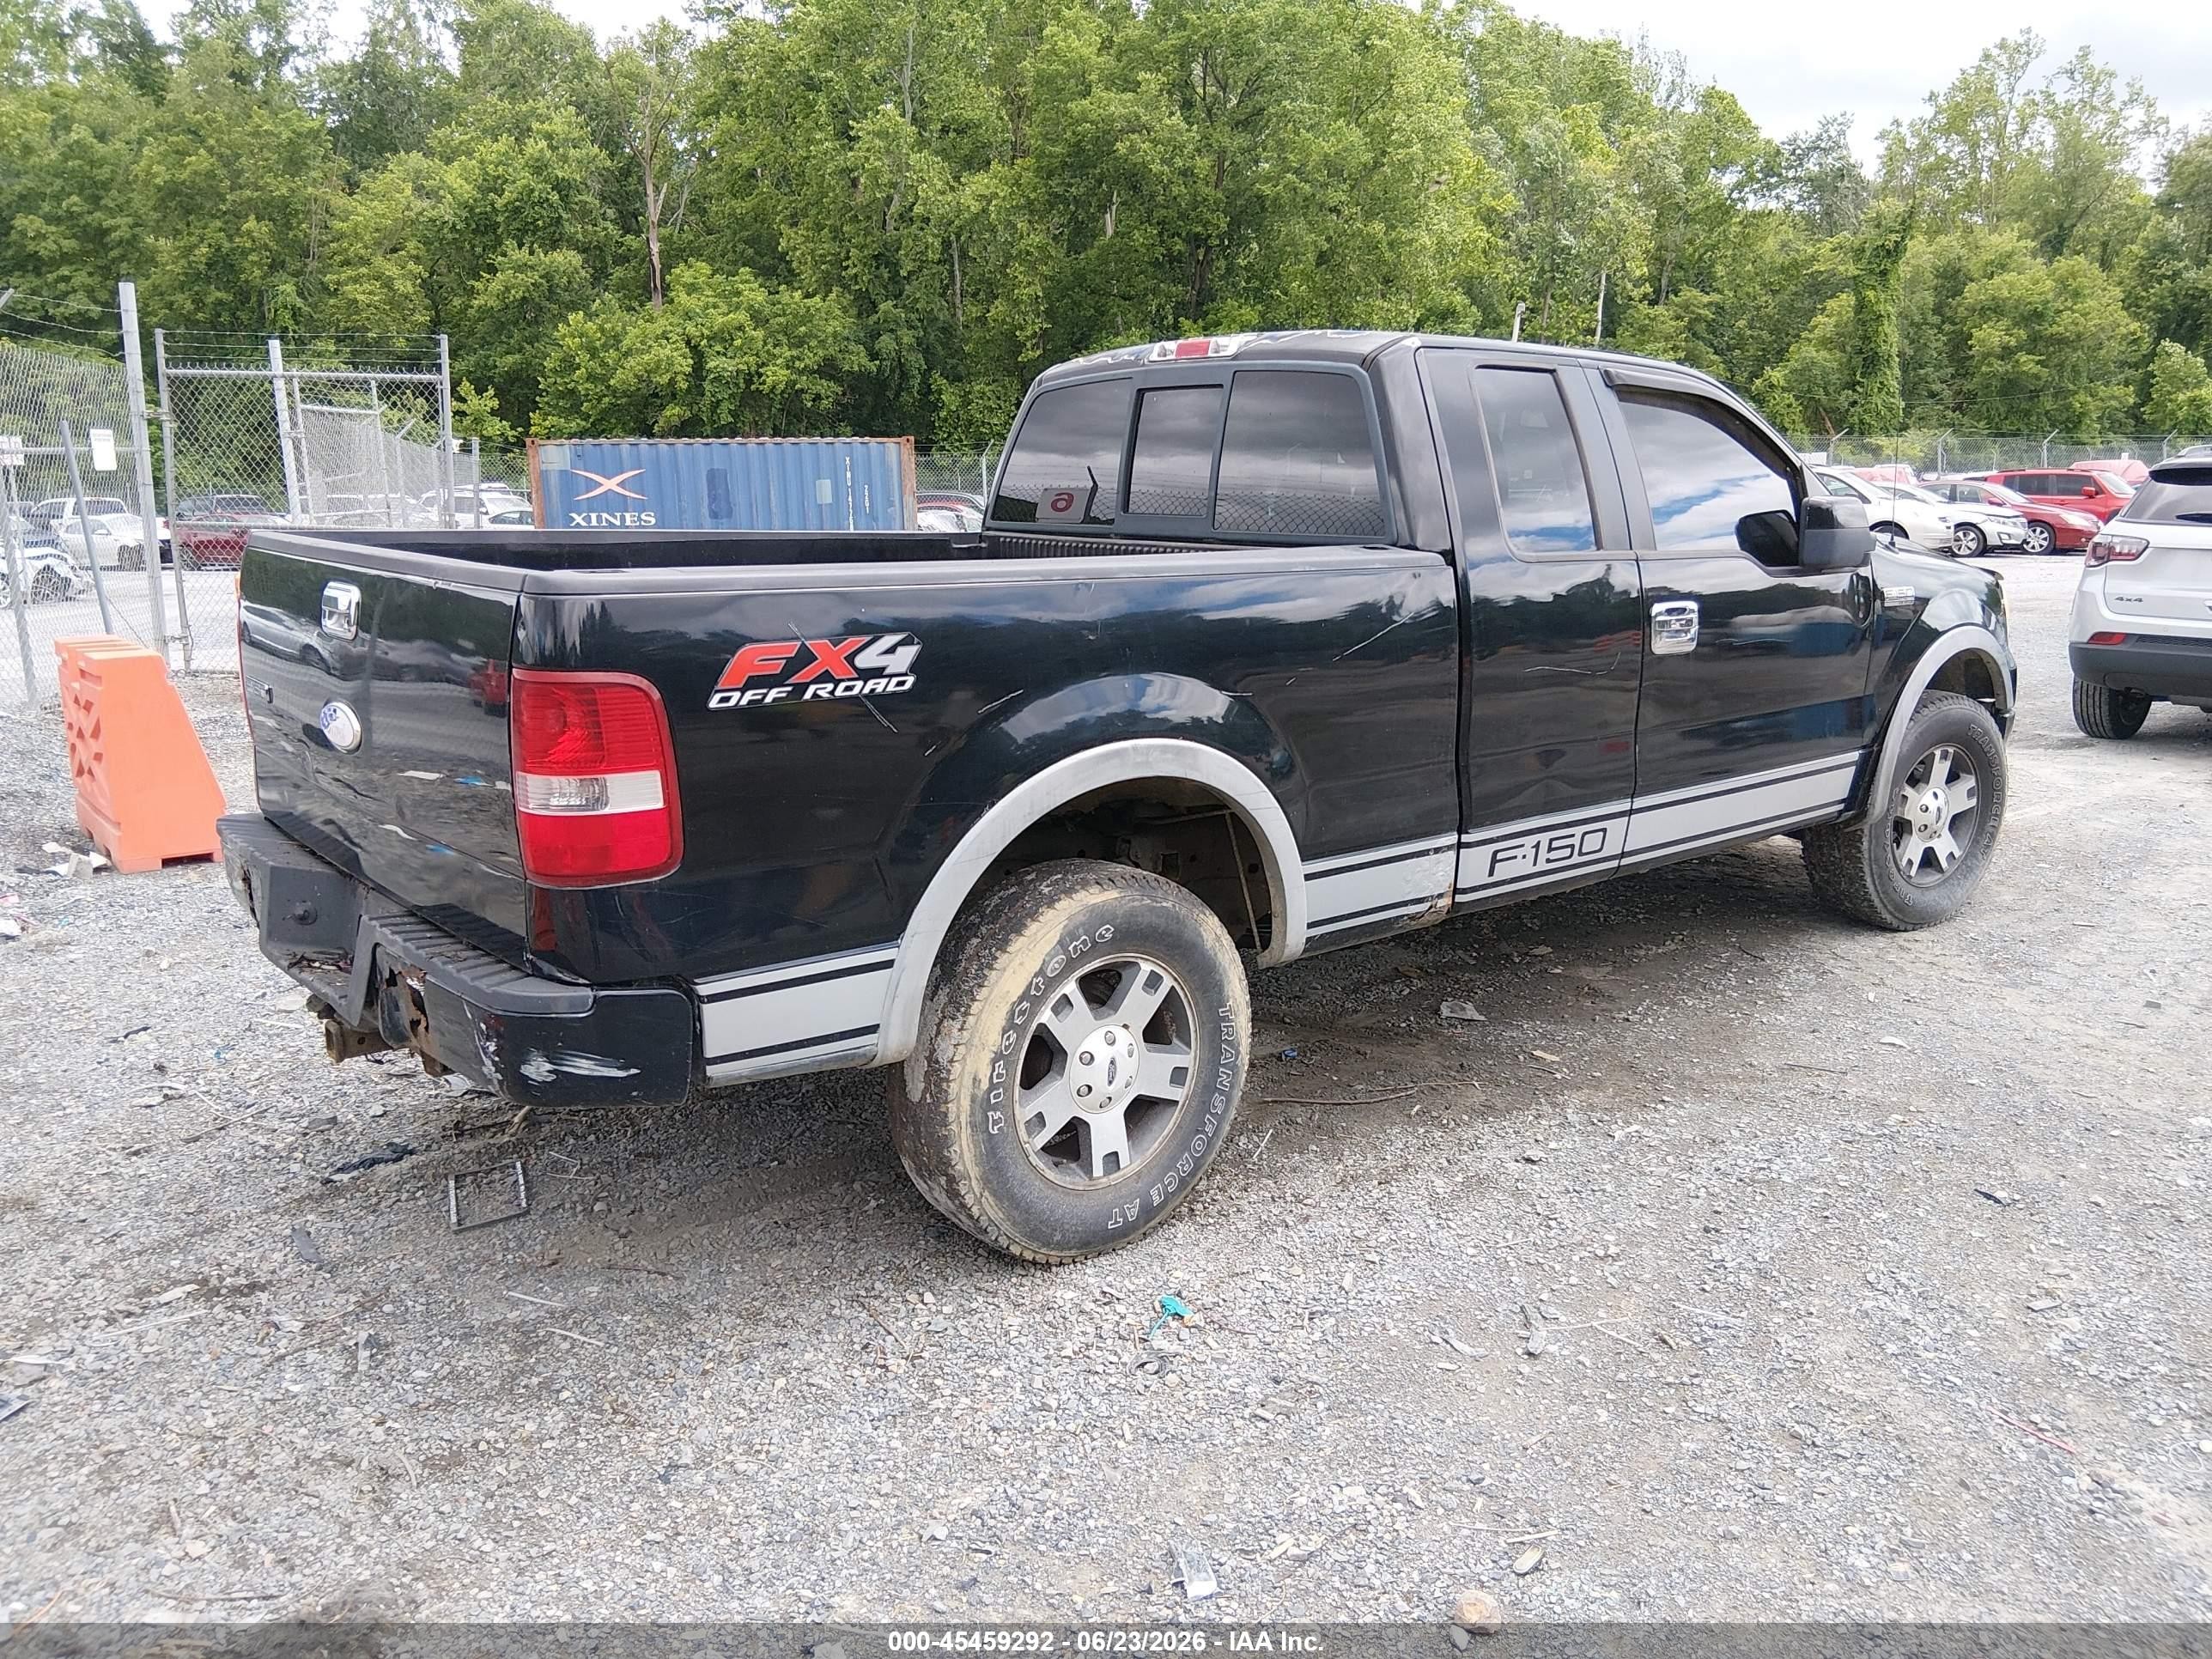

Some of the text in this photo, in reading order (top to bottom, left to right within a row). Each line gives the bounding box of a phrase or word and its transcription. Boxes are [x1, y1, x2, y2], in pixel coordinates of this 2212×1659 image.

[568, 511, 656, 526] XINES
[717, 633, 921, 690] FX4
[708, 675, 916, 708] OFF ROAD
[1107, 1003, 1235, 1230] TRANSFORCE AT
